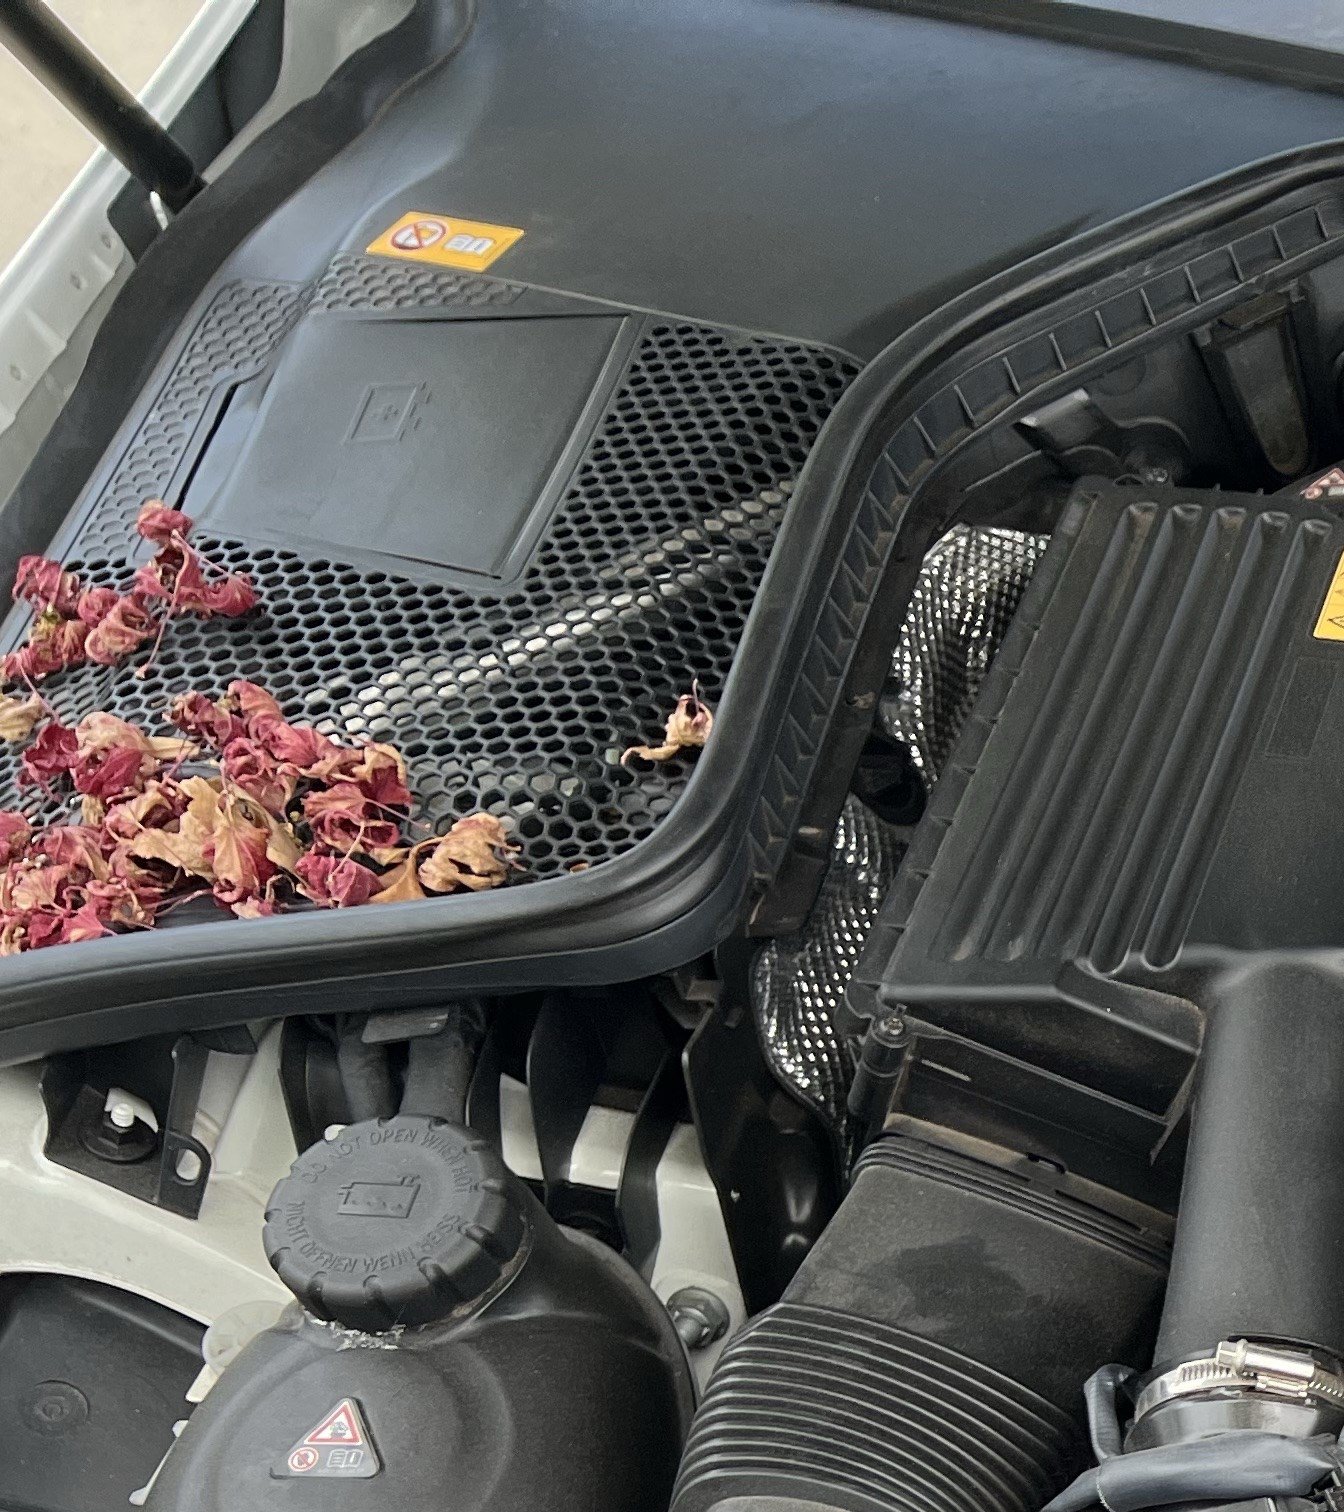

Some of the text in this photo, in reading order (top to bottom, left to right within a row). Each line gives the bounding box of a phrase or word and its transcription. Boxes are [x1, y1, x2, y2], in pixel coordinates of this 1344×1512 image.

[370, 1128, 419, 1146] OPEN
[420, 1130, 463, 1167] WHEN
[286, 1200, 310, 1243] NICHT
[362, 1246, 416, 1272] WENN
